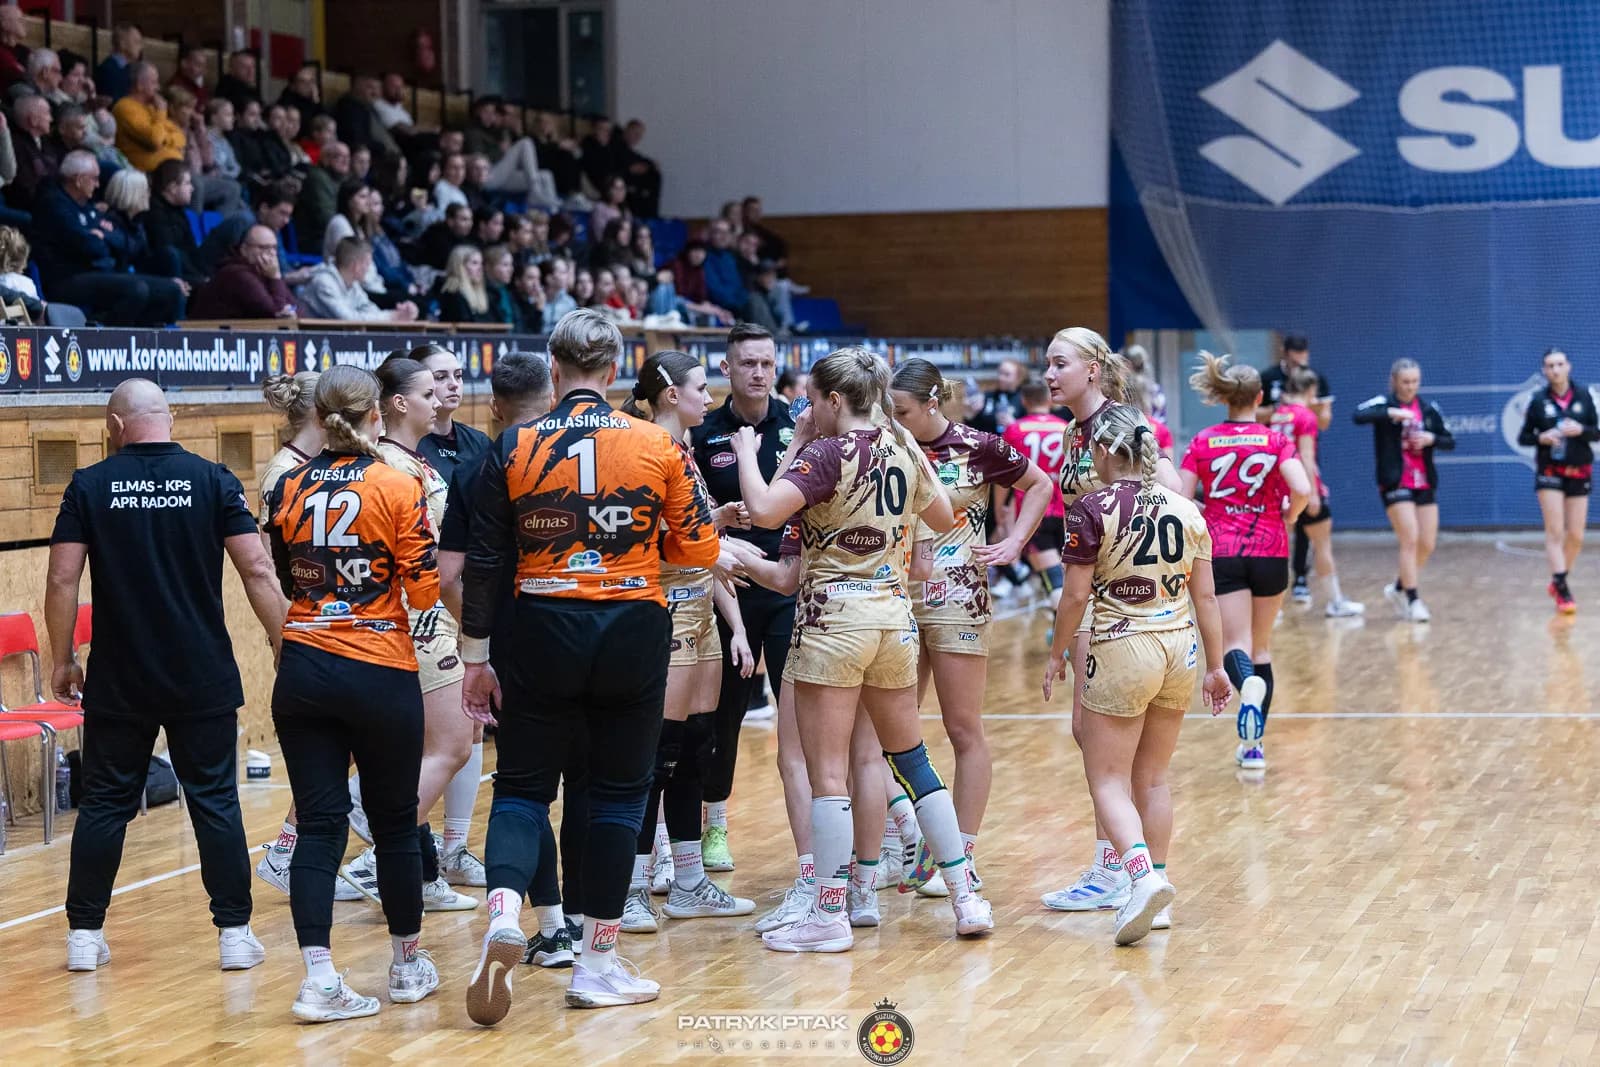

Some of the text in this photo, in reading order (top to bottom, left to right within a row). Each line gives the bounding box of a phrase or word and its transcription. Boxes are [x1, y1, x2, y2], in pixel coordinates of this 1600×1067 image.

[1397, 64, 1600, 173] SU
[87, 336, 264, 382] www.koronahandball.pl
[535, 412, 632, 431] KOLASIŃSKA
[1022, 431, 1064, 468] 19
[310, 468, 367, 482] CIEŚLAK
[567, 437, 598, 495] 1
[1060, 463, 1077, 494] 22
[1209, 451, 1278, 498] 29
[111, 480, 155, 493] ELMAS
[165, 479, 192, 492] KPS
[869, 466, 908, 517] 10
[110, 495, 192, 509] APR RADOM
[304, 491, 361, 548] 12
[525, 515, 569, 530] elmas
[588, 505, 652, 533] KPS
[782, 525, 800, 540] PS
[845, 531, 881, 546] elmas
[1064, 532, 1079, 548] PS
[1130, 514, 1184, 566] 20
[335, 557, 390, 586] KPS
[1115, 582, 1151, 595] elmas
